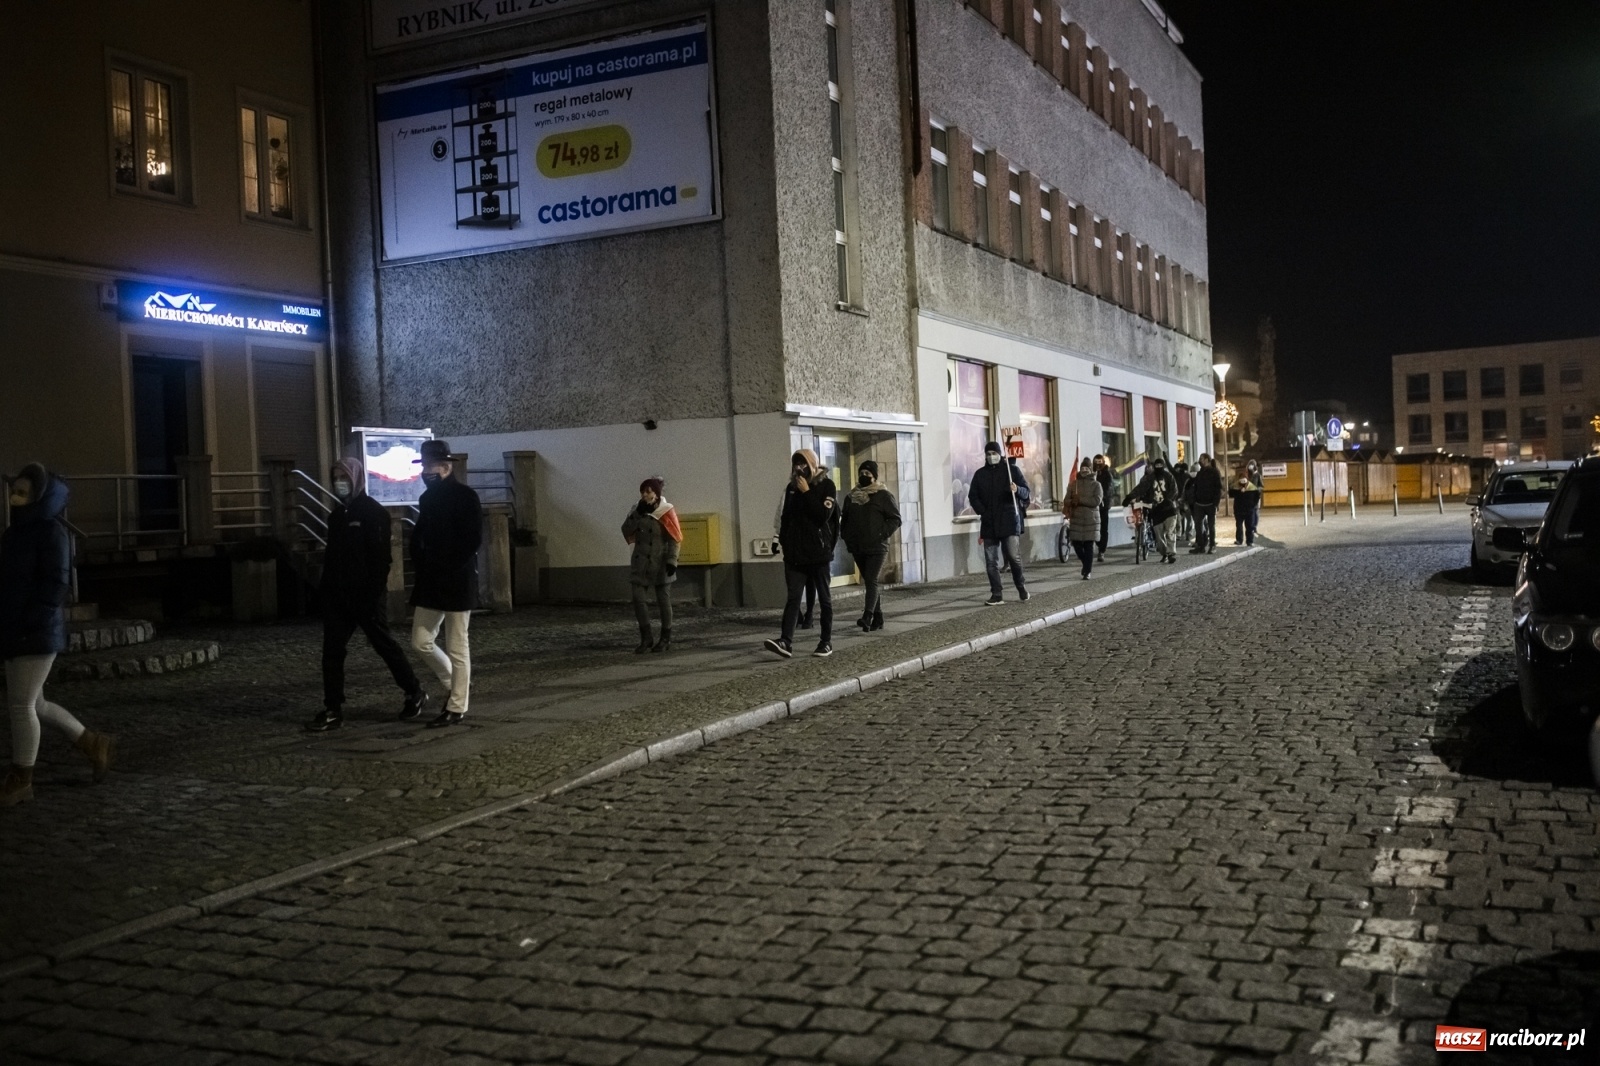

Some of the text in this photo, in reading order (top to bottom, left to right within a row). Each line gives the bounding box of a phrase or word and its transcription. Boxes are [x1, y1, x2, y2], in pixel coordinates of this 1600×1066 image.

[396, 0, 522, 37] RYBNIK, ul.
[531, 42, 696, 87] kupuj na castorama.pl
[534, 87, 633, 114] regał metalowy
[571, 112, 581, 121] 80
[587, 109, 597, 118] 40
[437, 144, 443, 154] 3
[548, 141, 620, 169] 74,98 zł
[538, 185, 677, 224] castorama
[282, 304, 321, 317] IMMOBILIEN
[247, 317, 308, 335] KARPIŃSCY
